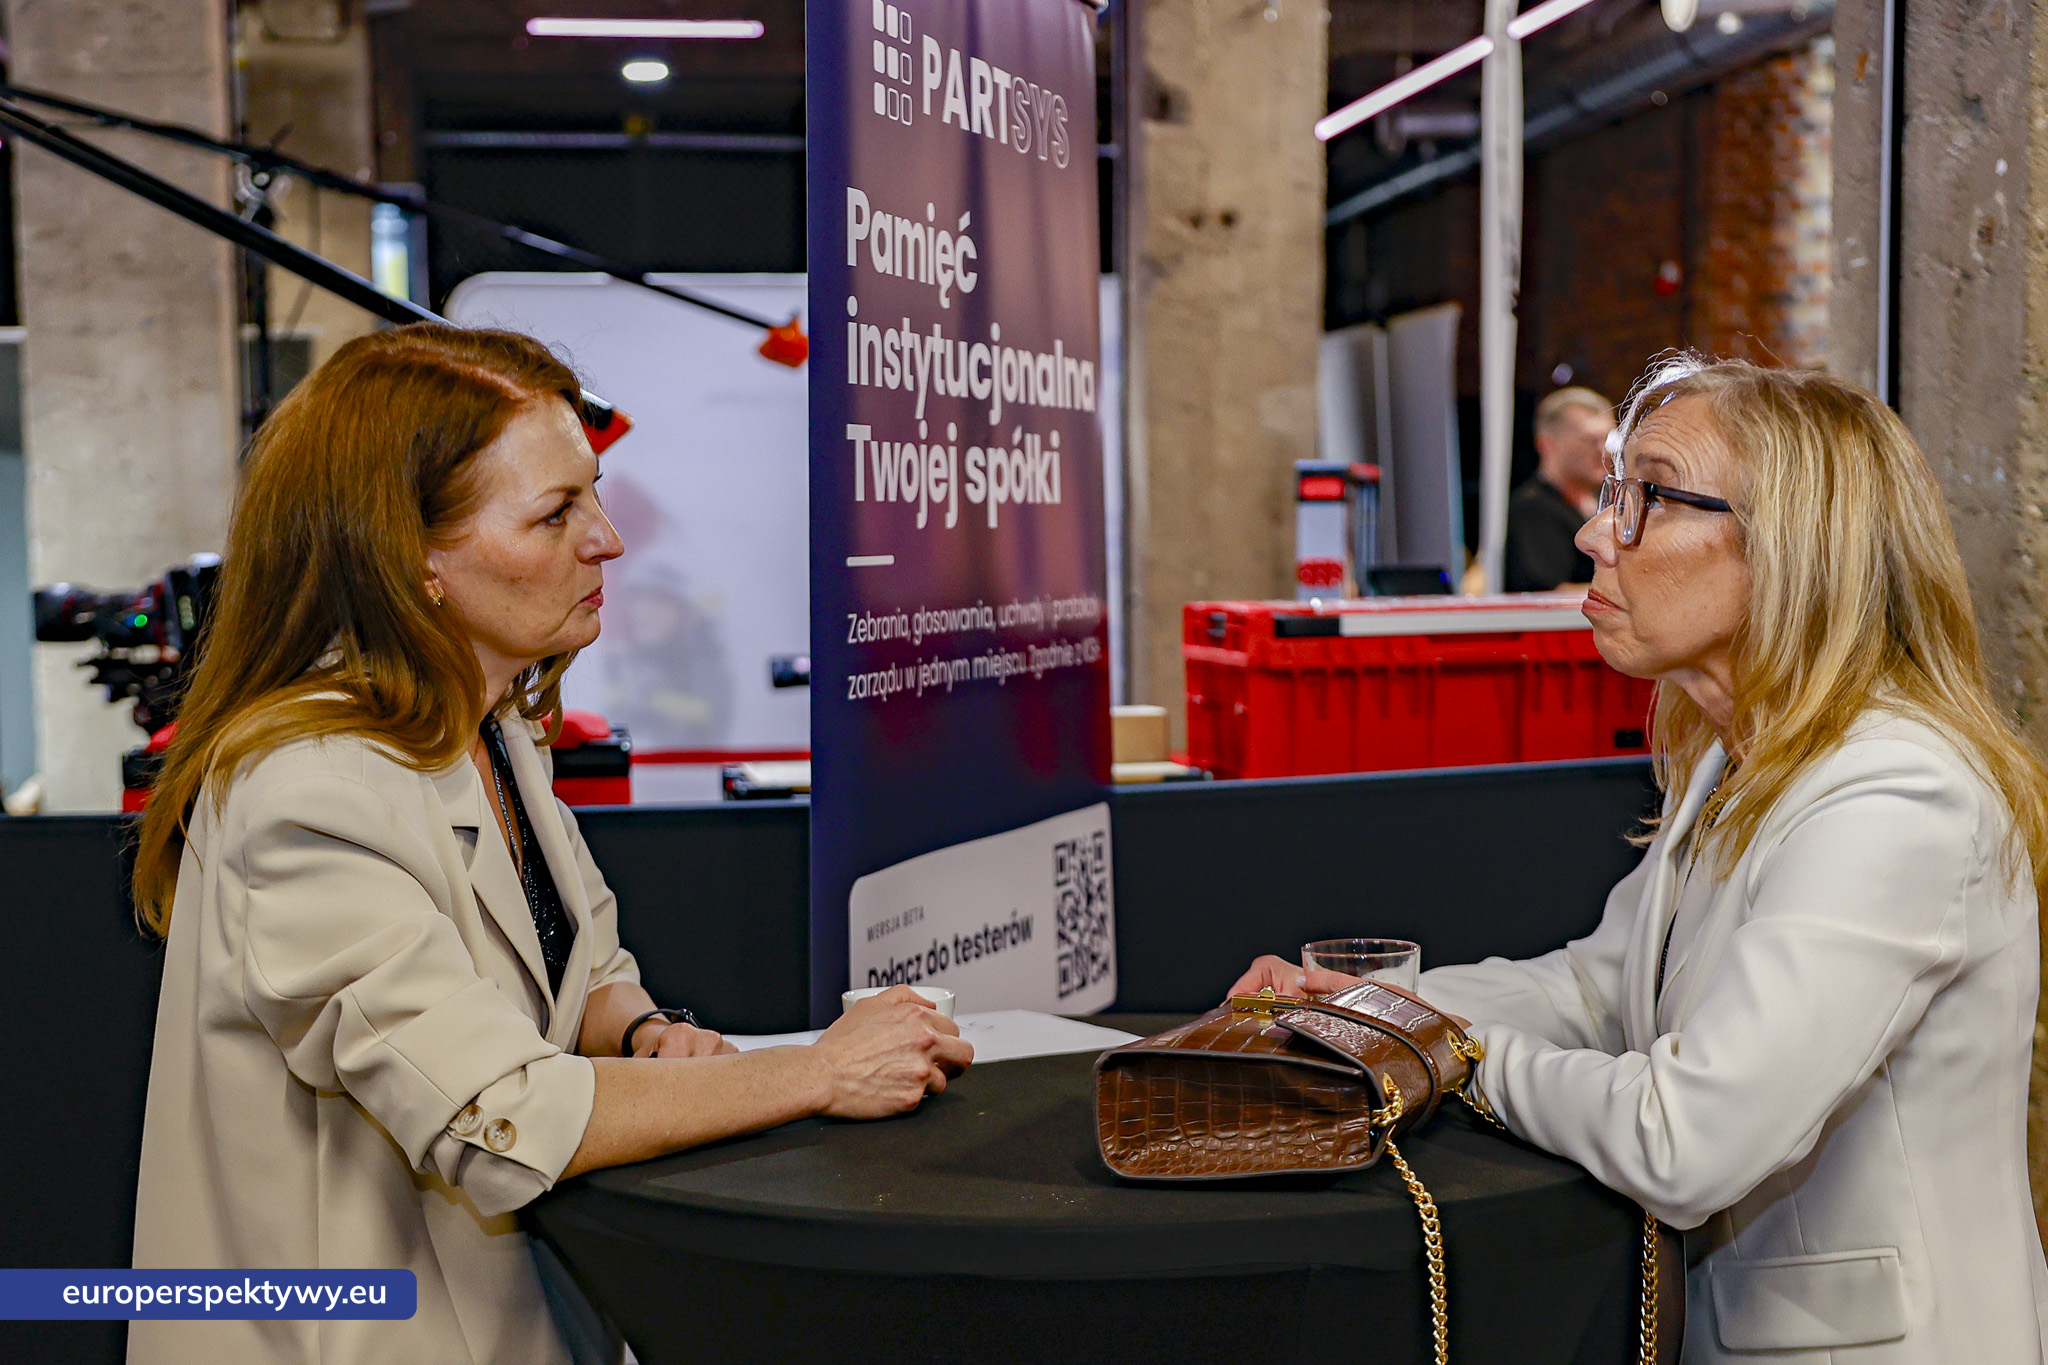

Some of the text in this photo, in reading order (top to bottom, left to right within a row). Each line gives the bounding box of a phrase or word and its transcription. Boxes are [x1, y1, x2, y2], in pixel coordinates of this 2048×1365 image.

[922, 33, 1070, 170] PARTSYS
[846, 186, 978, 309] Pamięć
[846, 295, 1095, 426] instytucjonalna
[846, 419, 1062, 529] Twojej spółki
[847, 607, 912, 645] Zebrania,
[912, 599, 997, 646] głosowania,
[847, 662, 902, 702] zarządu
[904, 667, 916, 689] w
[916, 655, 970, 698] jednym
[867, 906, 925, 942] WERSJA BETA
[927, 938, 949, 975] do
[953, 908, 1034, 965] testerów
